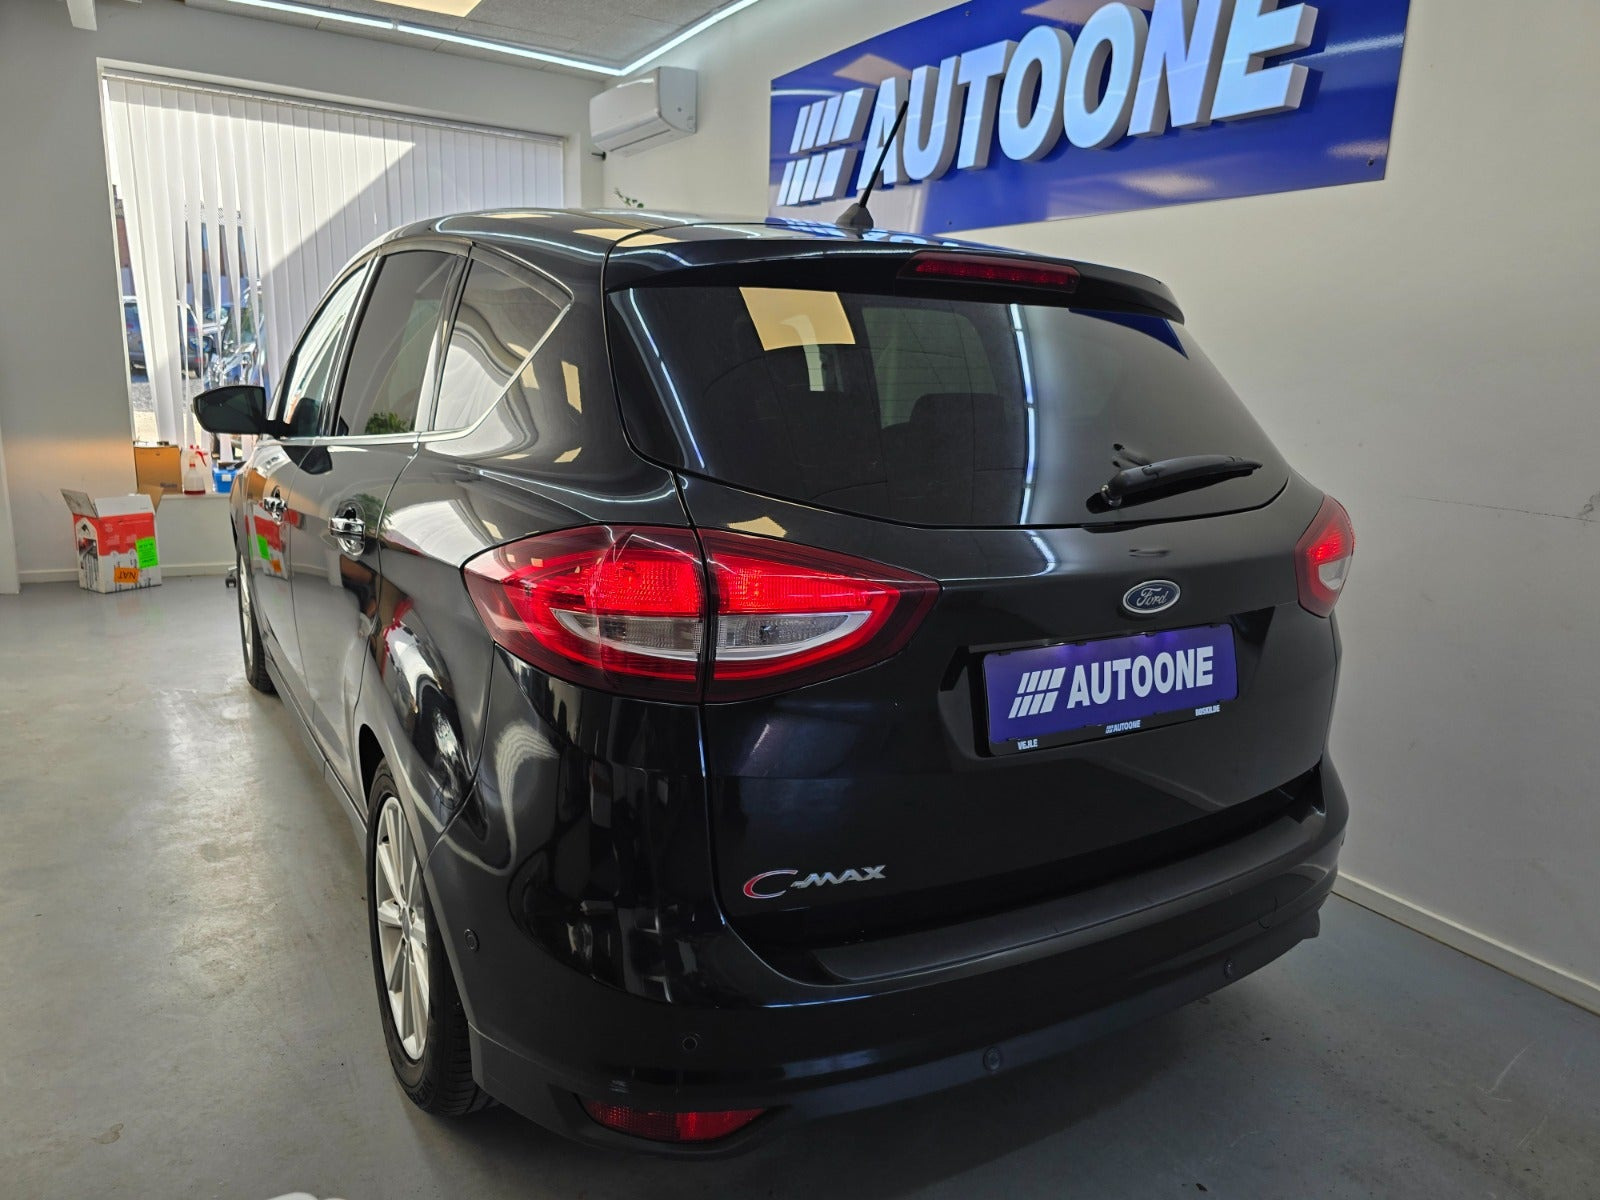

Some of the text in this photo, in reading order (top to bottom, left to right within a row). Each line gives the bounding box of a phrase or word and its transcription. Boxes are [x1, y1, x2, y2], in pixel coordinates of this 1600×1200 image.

[855, 0, 1317, 191] AUTOONE
[1136, 587, 1169, 607] Ford
[1066, 645, 1214, 709] AUTOONE
[1113, 720, 1141, 732] AUTOONE
[1017, 738, 1038, 750] VEJLE
[743, 864, 887, 899] C-MAX
